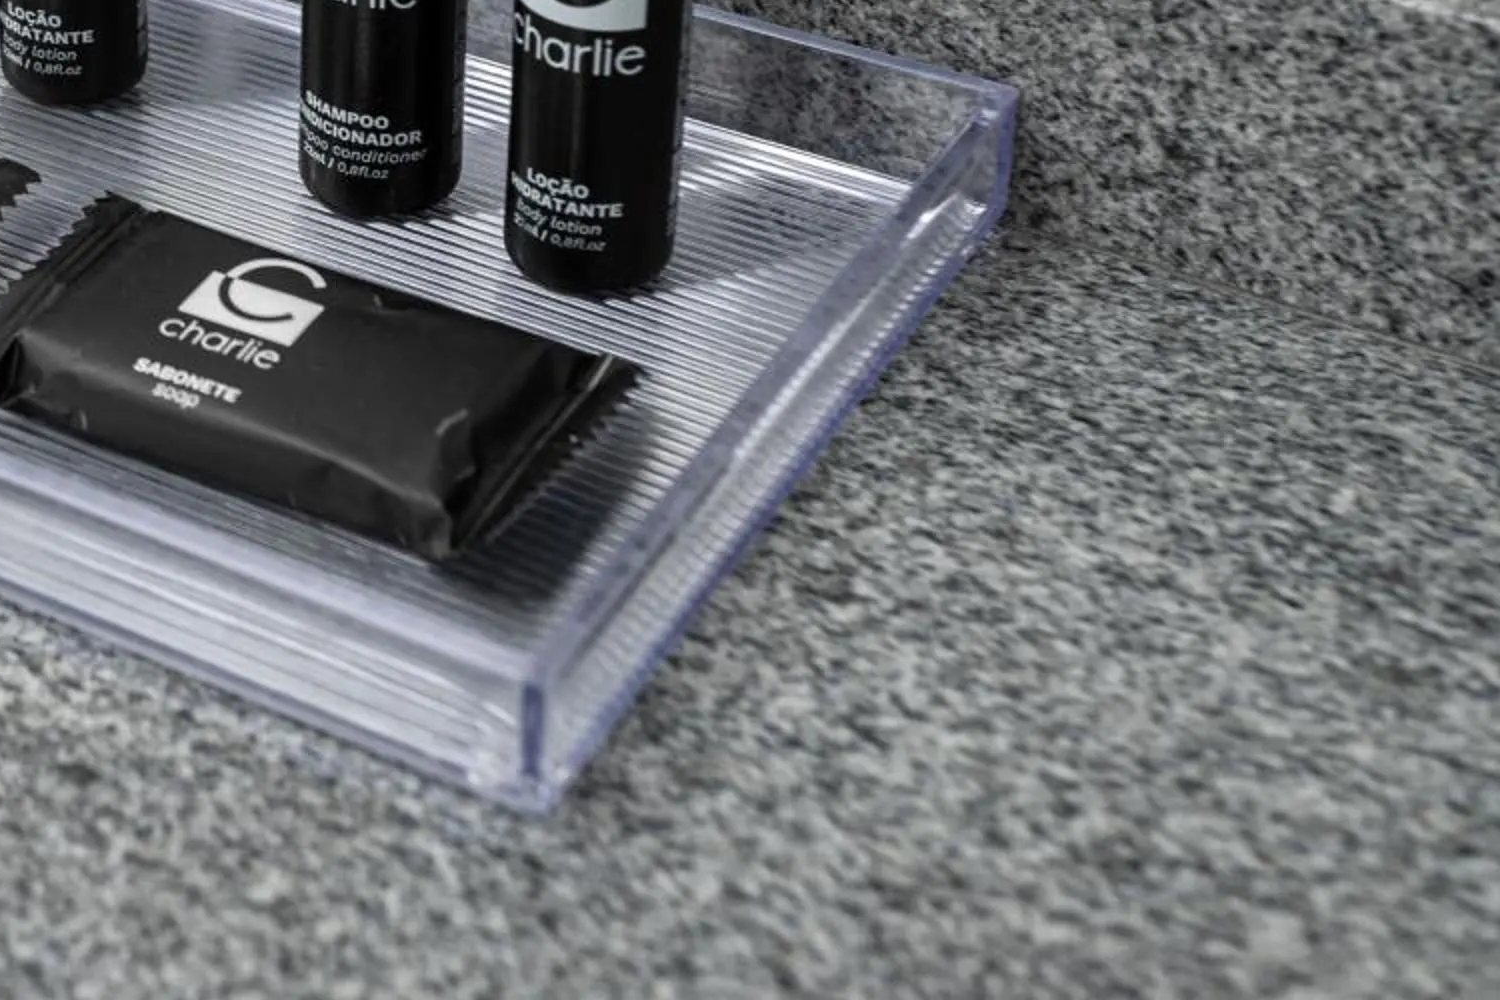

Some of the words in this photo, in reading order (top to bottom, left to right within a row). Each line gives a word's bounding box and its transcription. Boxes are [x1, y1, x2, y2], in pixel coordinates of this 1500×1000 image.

[7, 1, 62, 28] LOÇÃO
[306, 89, 389, 129] SHAMPOO
[526, 167, 590, 198] LOÇÃO
[550, 215, 603, 235] lotion
[158, 317, 281, 370] charlie
[132, 356, 242, 404] SABONETE
